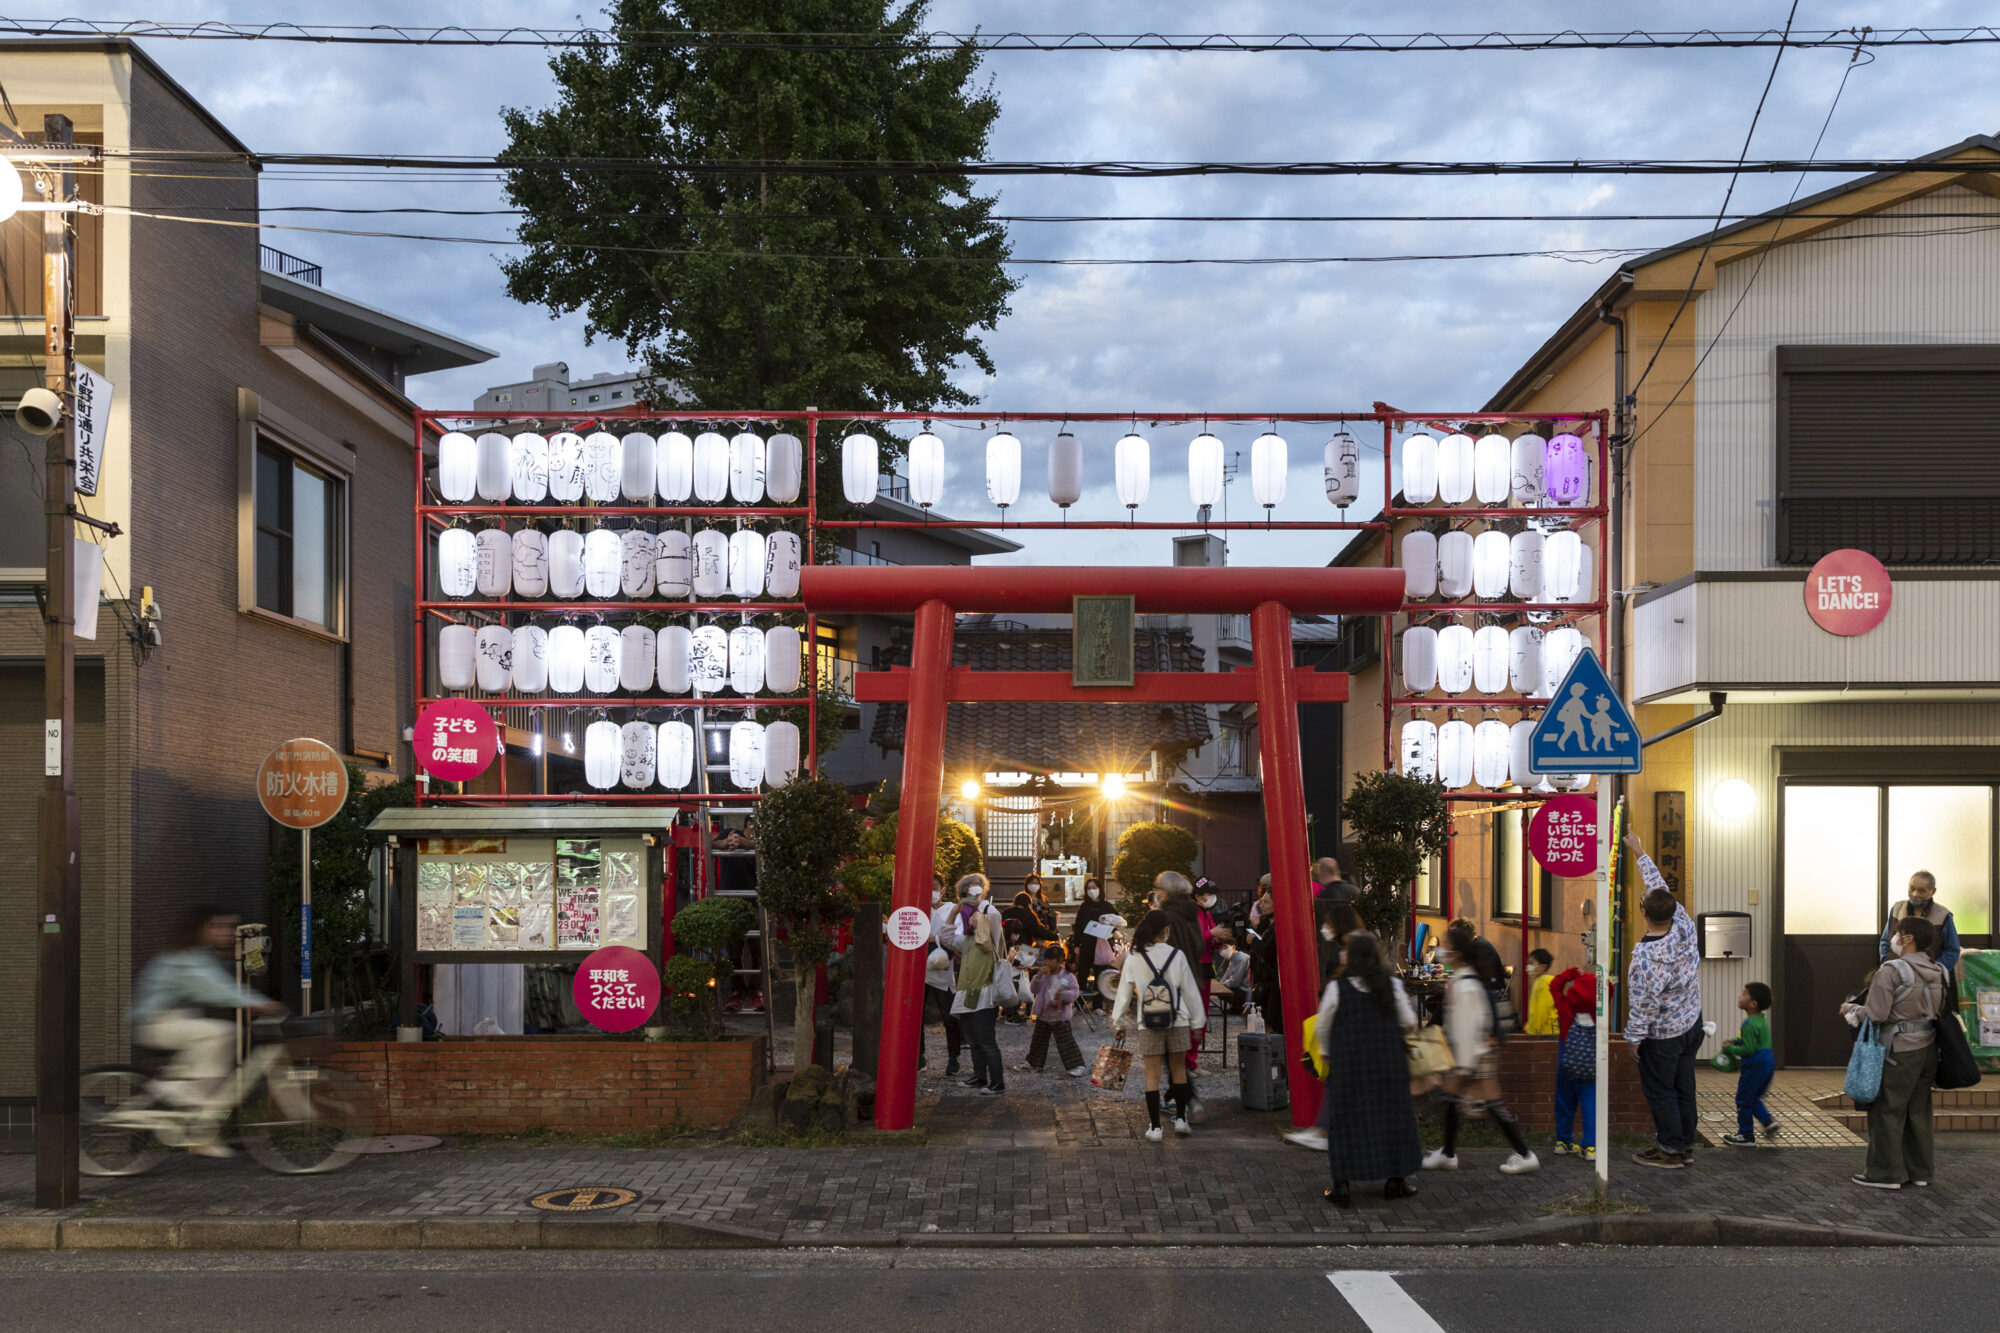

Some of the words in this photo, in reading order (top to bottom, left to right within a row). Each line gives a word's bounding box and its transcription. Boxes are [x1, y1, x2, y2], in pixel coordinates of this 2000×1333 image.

[77, 372, 96, 492] 小野町通り共栄会
[1818, 575, 1862, 592] LET'S
[1818, 592, 1879, 610] DANCE!
[433, 716, 477, 733] 子ども
[432, 732, 448, 747] 達
[432, 747, 478, 763] の笑顔
[266, 770, 338, 797] 防火水槽
[1547, 810, 1582, 823] きょう
[1547, 823, 1597, 836] いちにち
[1547, 837, 1585, 849] たのし
[1546, 849, 1584, 862] かった
[558, 920, 569, 930] 29
[558, 935, 596, 943] FESTIVAL
[589, 969, 629, 983] 平和を
[590, 983, 637, 996] つくって
[591, 995, 645, 1009] ください!
